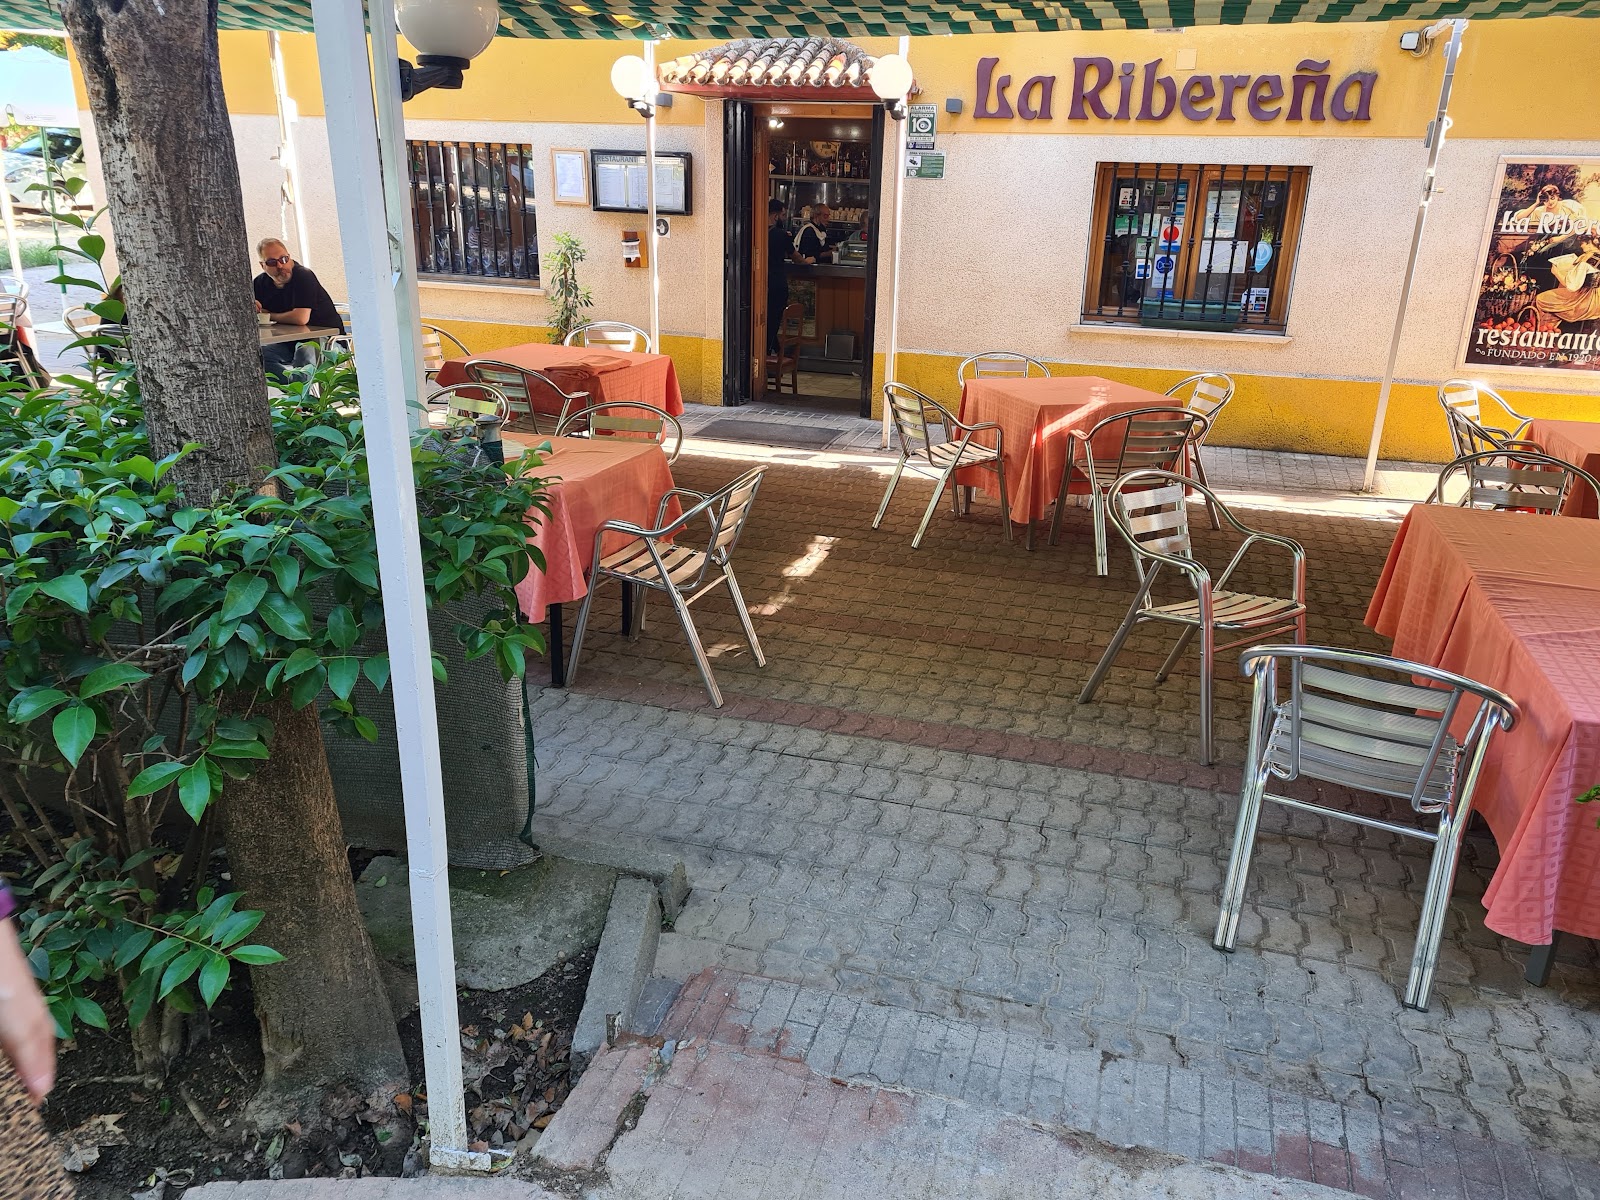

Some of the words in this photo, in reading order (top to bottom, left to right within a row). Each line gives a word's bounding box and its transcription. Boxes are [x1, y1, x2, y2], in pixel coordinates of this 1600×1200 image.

[973, 57, 1056, 119] La
[1067, 57, 1379, 121] Ribereña
[912, 117, 932, 133] 10
[1501, 210, 1530, 233] La
[1487, 348, 1546, 360] FUNDADO
[1549, 352, 1565, 361] EN
[1568, 353, 1592, 362] 1920
